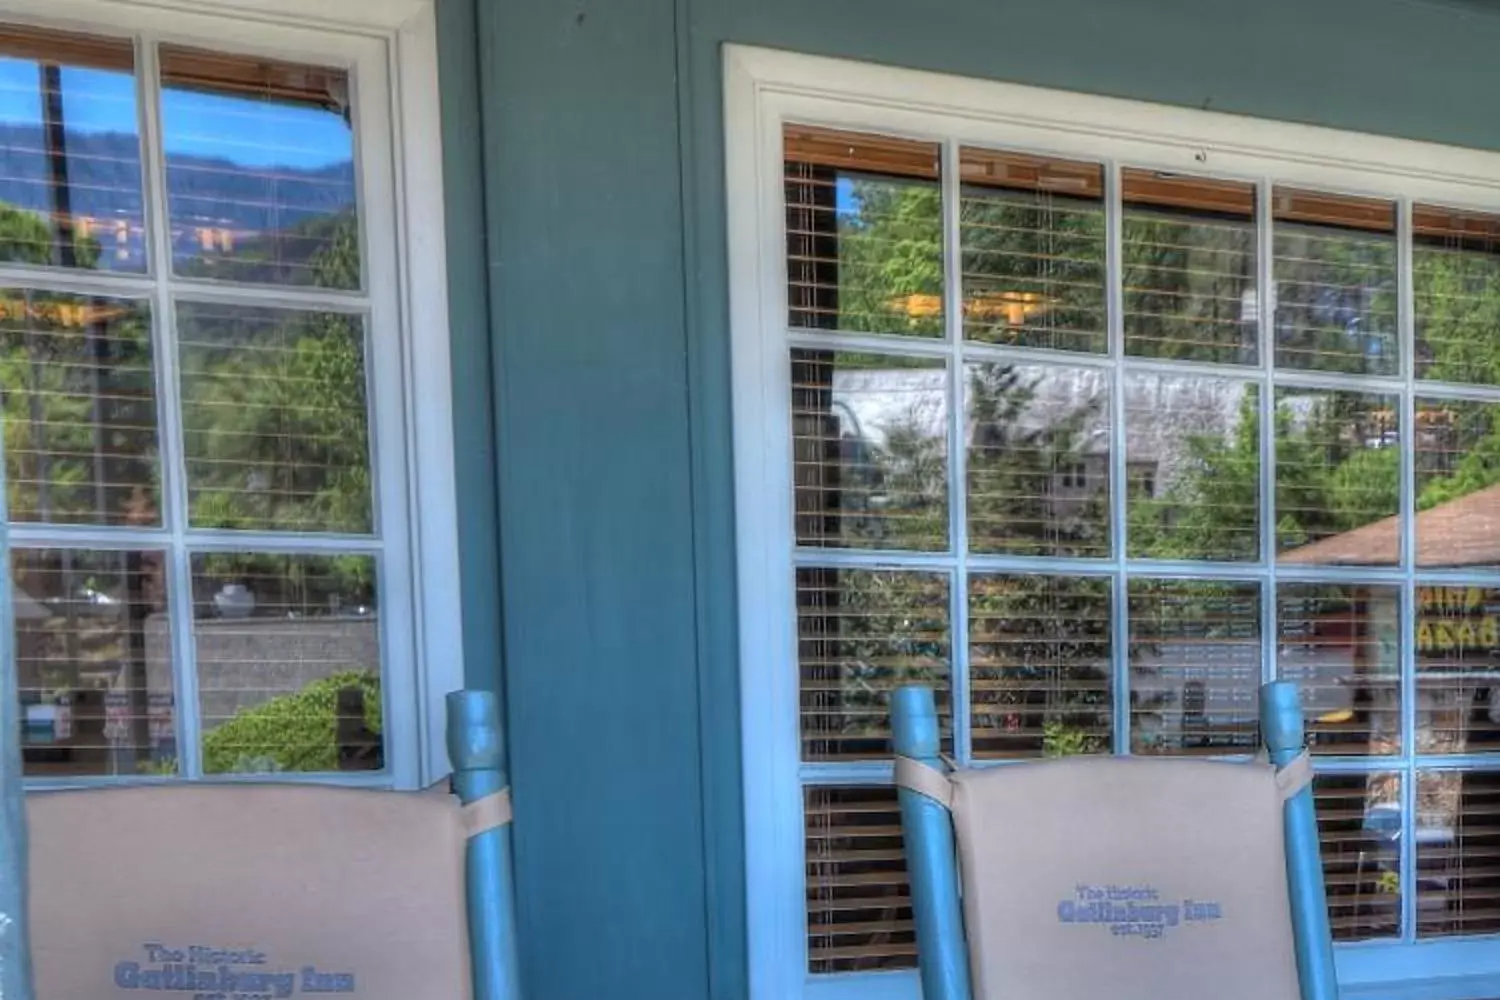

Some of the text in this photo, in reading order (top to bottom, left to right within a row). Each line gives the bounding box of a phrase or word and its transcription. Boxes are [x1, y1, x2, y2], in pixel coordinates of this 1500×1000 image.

[1184, 898, 1223, 920] Inn
[144, 943, 267, 965] The Historic
[113, 960, 355, 998] Gatlinburg Inn
